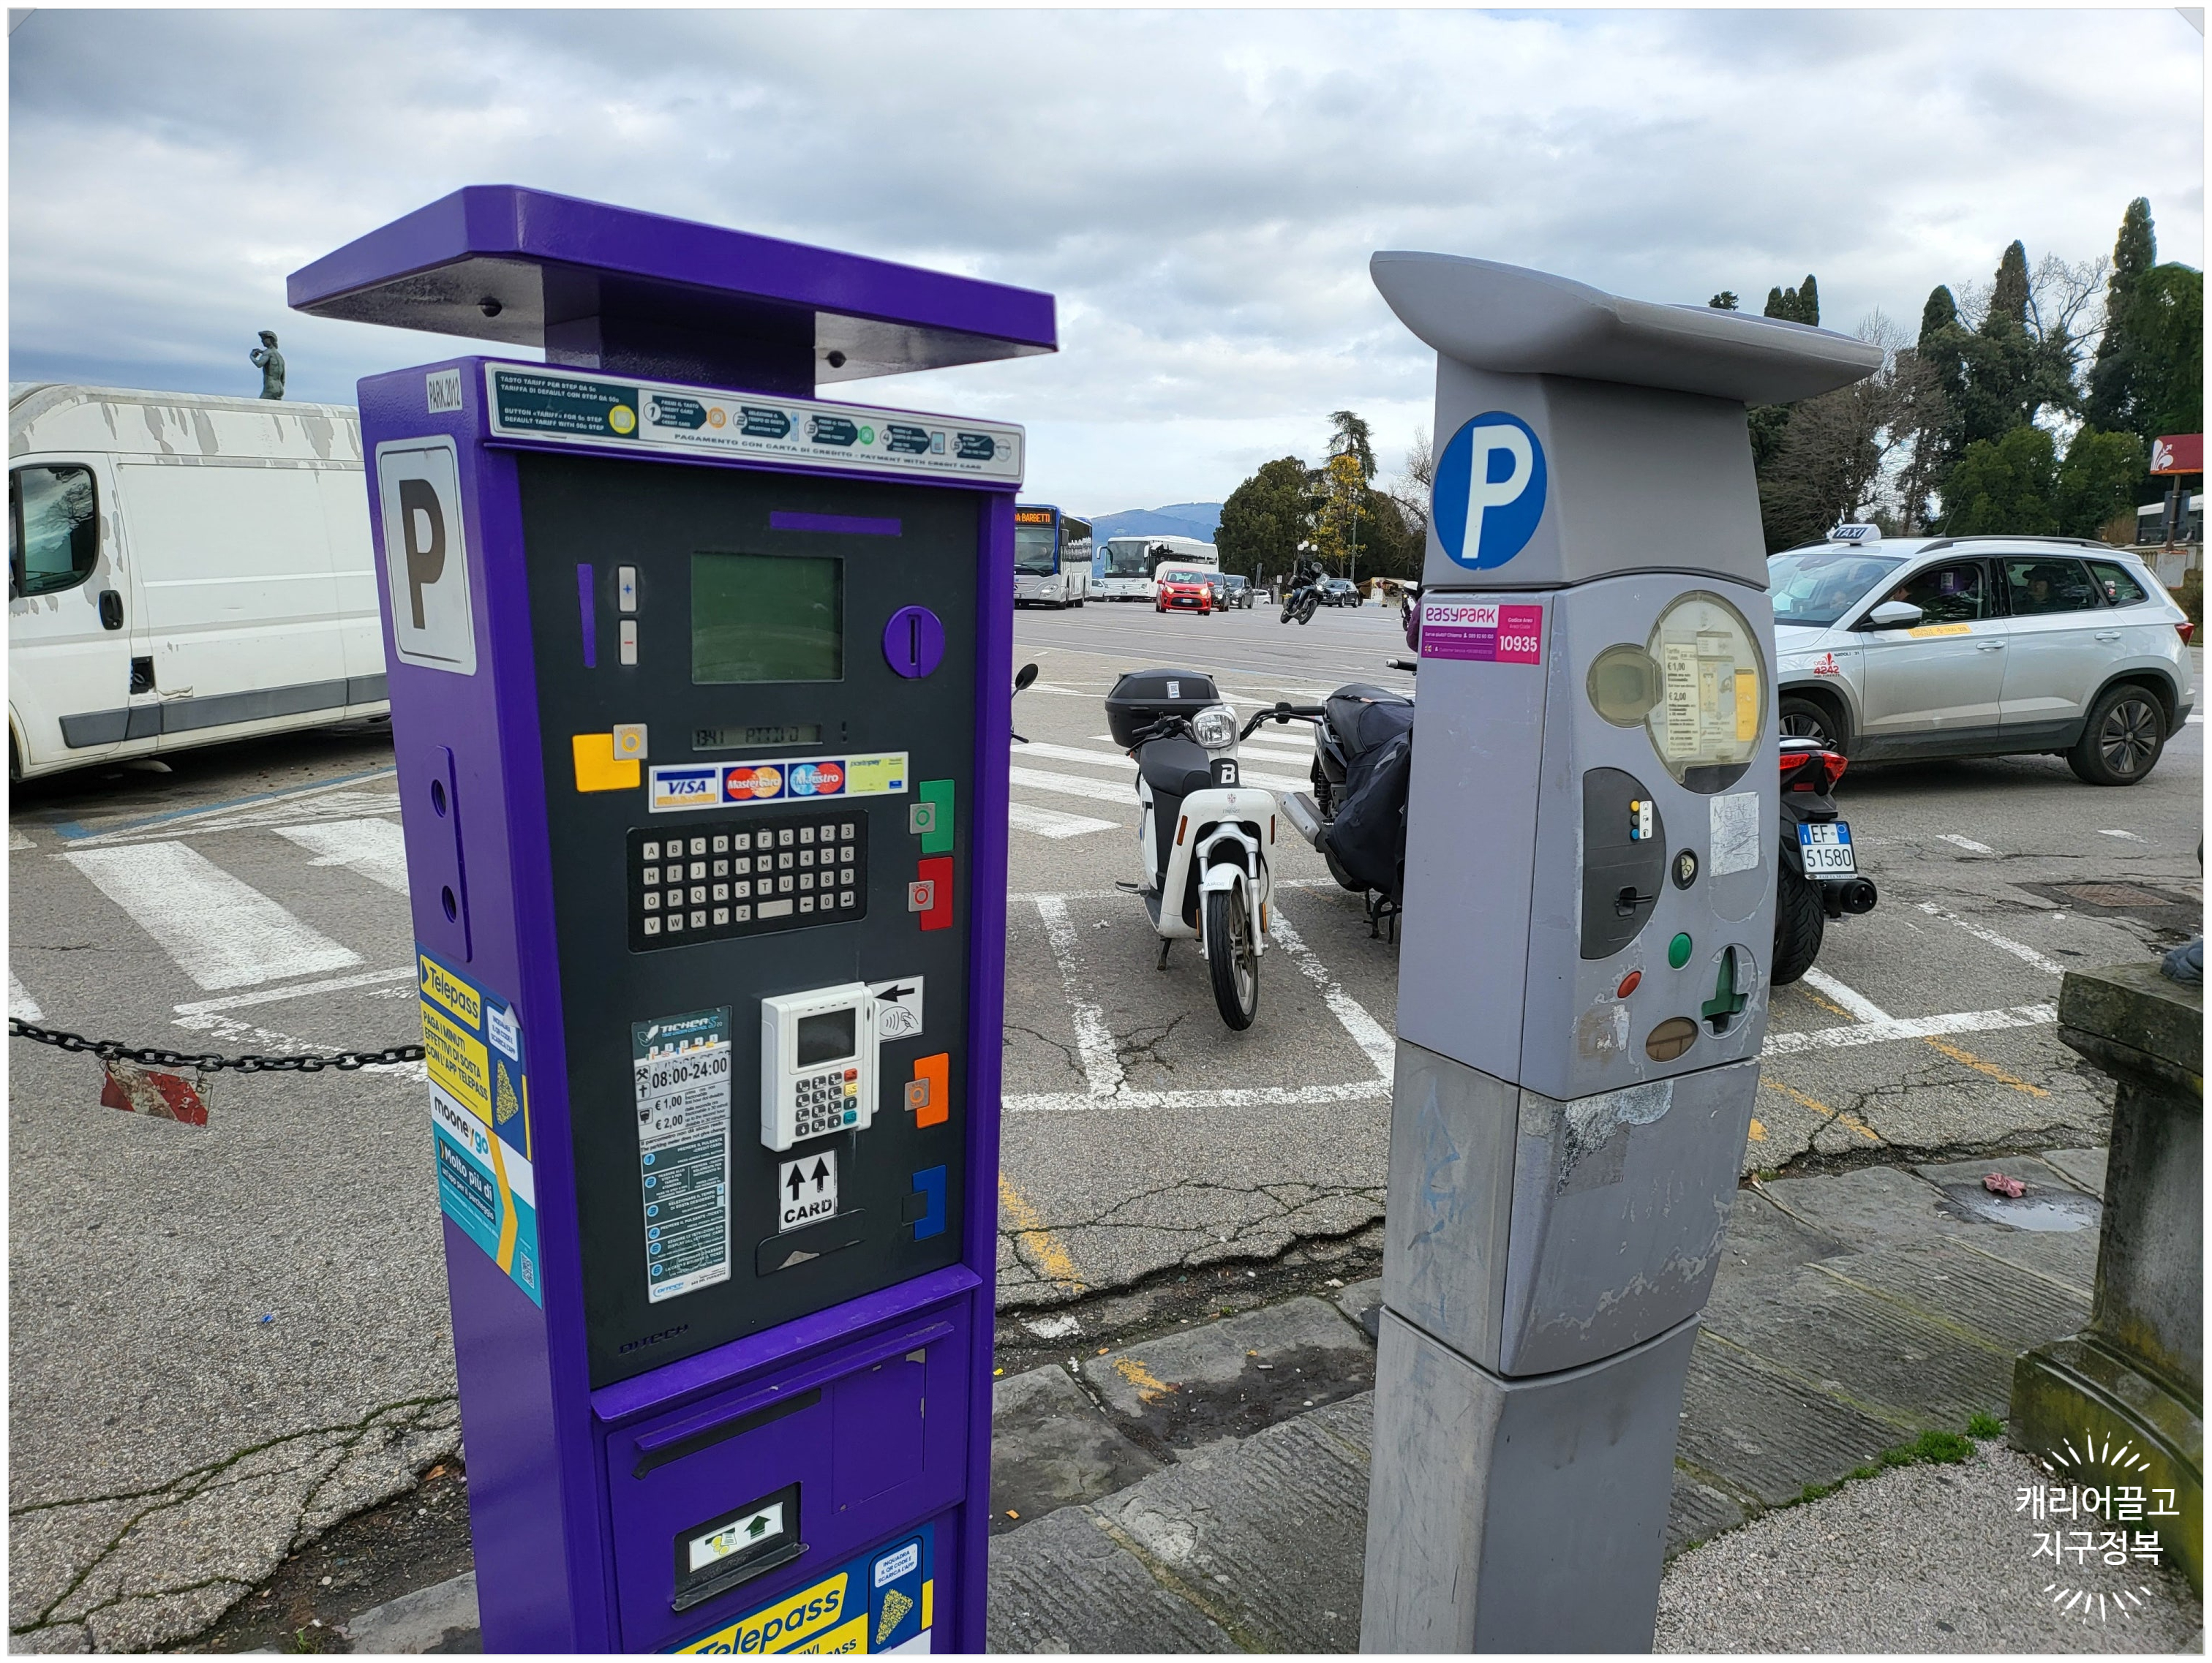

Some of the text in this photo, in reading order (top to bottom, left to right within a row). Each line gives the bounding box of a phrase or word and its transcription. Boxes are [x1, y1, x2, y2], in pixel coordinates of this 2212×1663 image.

[500, 376, 522, 384] TASTO
[524, 378, 546, 386] TARIFF
[548, 380, 560, 388] PER
[500, 385, 527, 393] TARIFFA
[538, 388, 565, 396] DEFAULT
[650, 407, 655, 418] 1
[736, 416, 746, 426] 2
[808, 425, 816, 434] 3
[674, 434, 738, 445] PAGAMENTO
[766, 443, 797, 452] CARTA
[813, 448, 852, 458] CREDITO
[860, 453, 900, 462] PAYMENT
[1462, 424, 1533, 559] P
[1022, 513, 1050, 522] BARBETTI
[1835, 528, 1866, 538] TAXI
[399, 479, 445, 629] P
[1500, 636, 1537, 652] 10935
[1674, 663, 1685, 671] 1,00
[1813, 665, 1840, 674] 4242
[1674, 693, 1686, 701] 2,00
[795, 774, 838, 785] Maestro
[1221, 764, 1235, 783] B
[668, 780, 706, 795] VISA
[728, 777, 780, 790] MasterCard
[1811, 825, 1827, 842] EF
[648, 847, 655, 856] A
[672, 845, 677, 853] B
[695, 842, 701, 851] C
[718, 840, 724, 848] D
[740, 838, 745, 846] E
[783, 834, 789, 842] G
[825, 829, 830, 837] 2
[1807, 849, 1851, 867] 51580
[649, 872, 655, 880] H
[673, 870, 677, 878] I
[696, 867, 700, 875] J
[718, 864, 724, 872] K
[741, 862, 745, 870] L
[761, 860, 768, 868] M
[805, 854, 809, 862] 4
[649, 897, 655, 905] O
[673, 894, 678, 902] P
[695, 891, 701, 900] Q
[718, 889, 724, 897] R
[740, 886, 745, 894] S
[763, 883, 768, 891] T
[825, 875, 830, 883] 8
[913, 884, 930, 893] CANCEL
[650, 921, 655, 930] V
[671, 919, 680, 927] W
[696, 916, 701, 924] X
[718, 912, 724, 921] Y
[741, 910, 746, 918] Z
[429, 967, 478, 1019] Telepass
[424, 1011, 438, 1031] PAGA
[443, 1025, 465, 1052] MINUTI
[425, 1027, 481, 1080] EFFETTIVI DI SOSTA
[426, 1044, 440, 1063] CON
[445, 1060, 456, 1076] APP
[458, 1068, 488, 1101] TELEPASS
[652, 1057, 726, 1088] 08:00-24:00
[655, 1096, 682, 1110] € 1,00
[656, 1115, 682, 1130] € 2,00
[445, 1146, 492, 1201] Molto più di
[469, 1192, 494, 1220] parcheggio
[784, 1199, 832, 1223] CARD
[883, 1550, 910, 1567] INQUADRA
[894, 1559, 908, 1568] CODE
[879, 1561, 914, 1583] SCARICA L'APP
